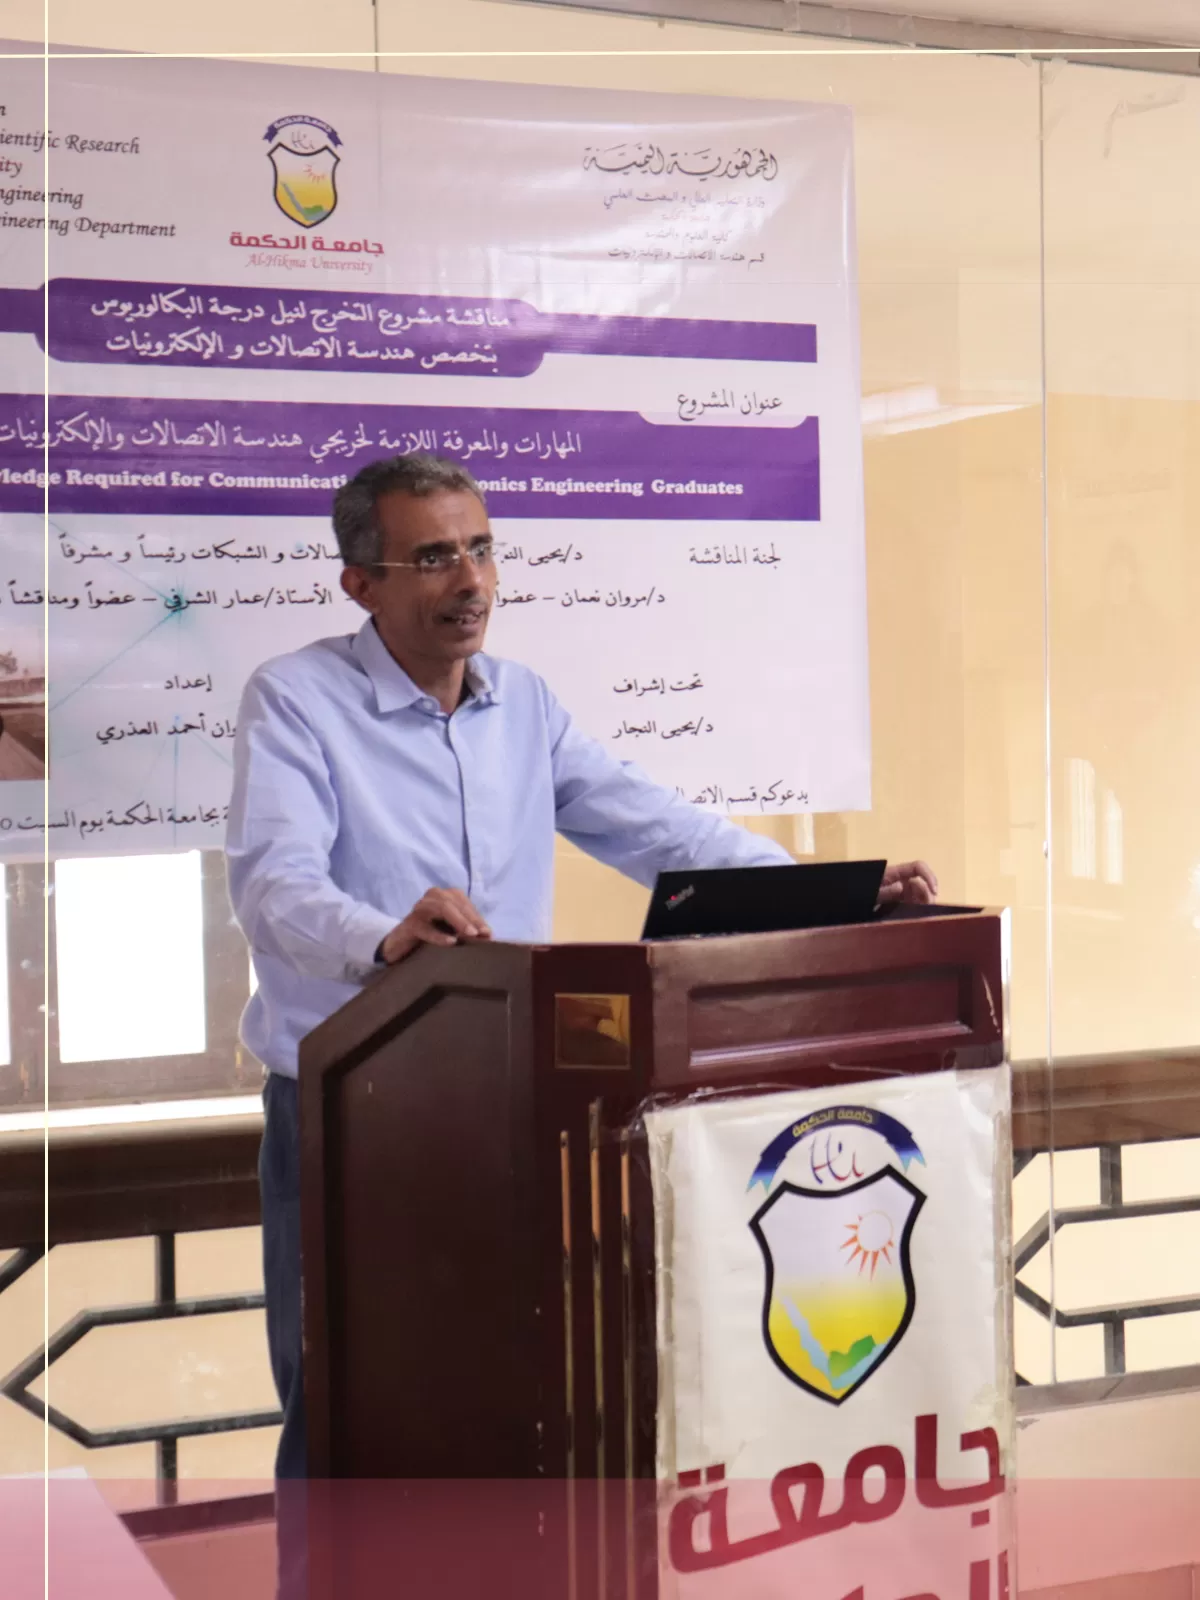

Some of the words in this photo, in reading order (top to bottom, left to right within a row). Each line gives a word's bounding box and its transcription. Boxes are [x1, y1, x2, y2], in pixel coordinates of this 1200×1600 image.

[0, 128, 60, 152] ientific
[65, 134, 140, 154] Research
[0, 185, 83, 210] ngineering
[0, 211, 69, 236] ineerng
[74, 216, 176, 239] Department
[229, 231, 306, 250] الحكمة
[311, 236, 385, 257] جامعة
[90, 291, 204, 324] البكالوريوس
[208, 297, 266, 323] درجة
[270, 299, 307, 326] لنيل
[308, 301, 374, 334] التخرج
[445, 305, 511, 328] مناقشة
[377, 306, 442, 336] مشروع
[105, 325, 225, 361] الإلكترونيات
[227, 343, 245, 361] و
[249, 333, 343, 360] الاتصالات
[347, 340, 415, 362] هندسة
[420, 343, 499, 374] بتخصص
[676, 387, 737, 423] المشروع
[739, 391, 784, 416] عنوان
[130, 417, 228, 448] الاتصالات
[232, 426, 304, 450] هندسة
[308, 422, 374, 464] لخريجي
[377, 427, 439, 457] اللازمة
[441, 428, 510, 460] والمعرفة
[513, 430, 582, 460] المهارات
[0, 467, 61, 489] ledge
[65, 469, 168, 489] Required
[171, 470, 204, 487] for
[208, 472, 348, 490] Communicati
[473, 476, 527, 493] onics
[530, 477, 645, 497] Engineering
[650, 479, 744, 495] Graduates
[117, 549, 132, 563] و
[190, 538, 269, 564] الشبكات
[271, 550, 285, 564] و
[688, 544, 748, 566] المناقشة
[752, 541, 781, 570] لجنة
[163, 587, 217, 613] الشرفي
[560, 588, 601, 607] نعمان
[163, 673, 213, 693] إعداد
[612, 677, 666, 697] إشراف
[669, 672, 704, 691] تحت
[95, 720, 159, 745] العذري
[166, 712, 207, 736] أحمد
[611, 719, 657, 739] النجار
[726, 786, 757, 812] قسم
[17, 810, 77, 831] السبت
[106, 800, 164, 827] الحكمة
[78, 815, 105, 840] يوم
[669, 1413, 1007, 1575] جامعة
